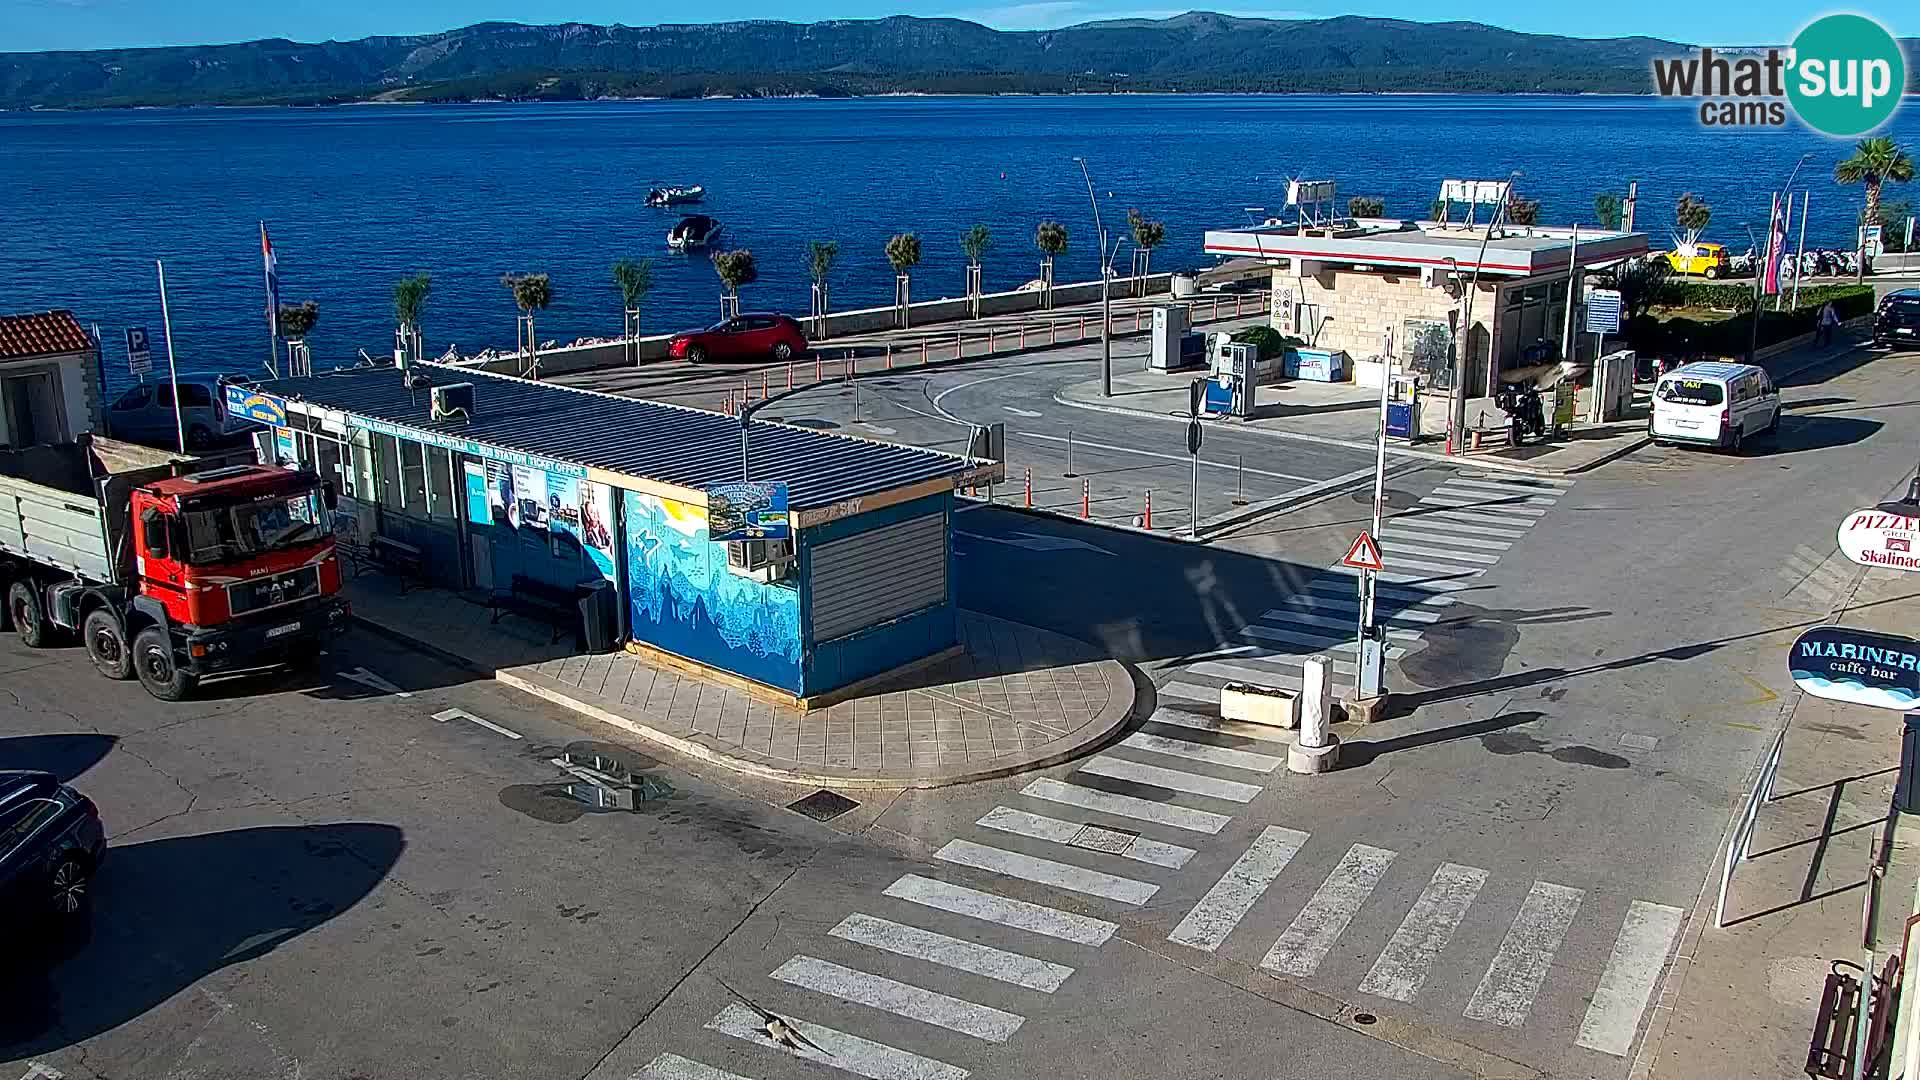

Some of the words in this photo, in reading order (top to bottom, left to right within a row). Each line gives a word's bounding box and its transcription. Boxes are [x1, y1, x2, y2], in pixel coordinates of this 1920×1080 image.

[1683, 381, 1701, 389] TAXI
[495, 449, 527, 464] STATION
[529, 456, 555, 471] TICKET
[556, 462, 586, 477] OFFICE
[1850, 515, 1920, 532] PIZZE
[256, 579, 295, 595] MAN
[1830, 661, 1866, 675] caffe
[1871, 665, 1898, 680] bar
